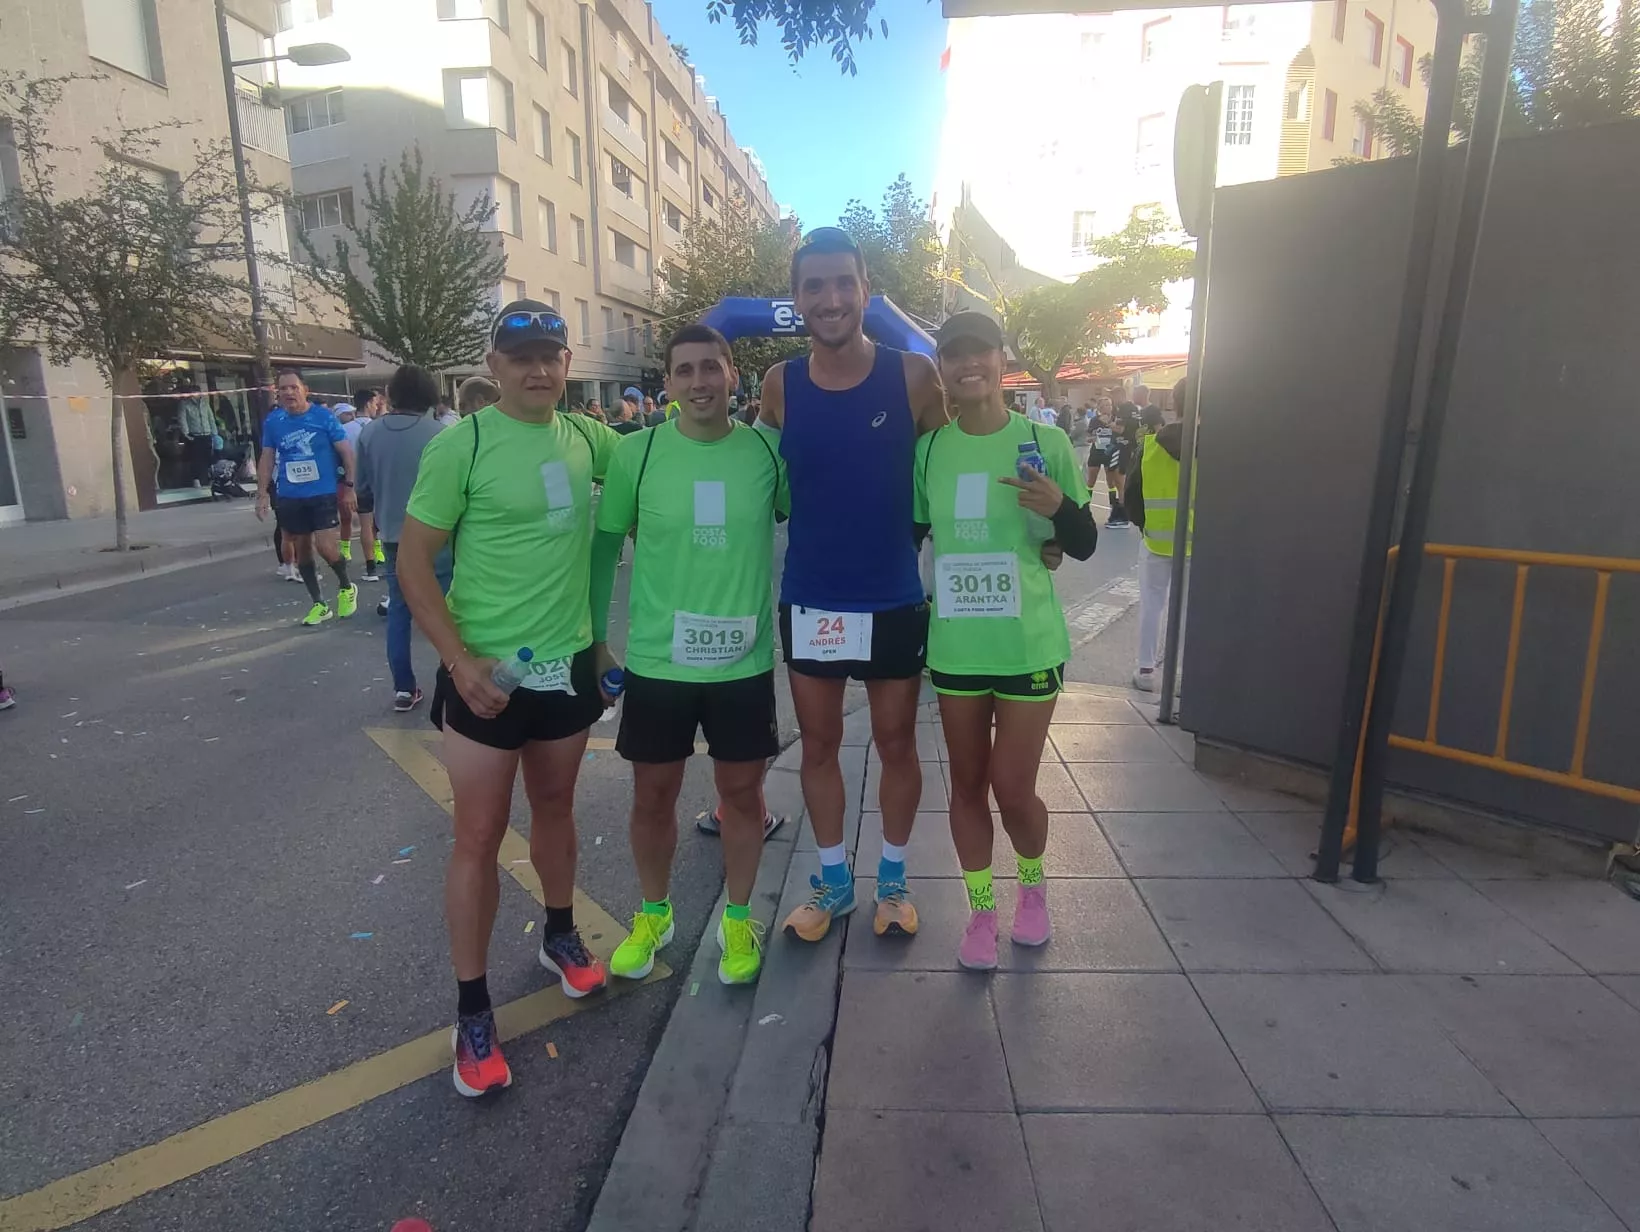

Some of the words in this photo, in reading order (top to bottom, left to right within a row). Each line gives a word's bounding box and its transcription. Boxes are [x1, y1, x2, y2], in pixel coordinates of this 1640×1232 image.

[954, 520, 989, 530] COSTA
[692, 527, 728, 536] COSTA
[955, 530, 989, 541] FOOD
[693, 536, 727, 546] FOOD
[949, 573, 1012, 593] 3018
[955, 595, 1008, 605] ARANTXA
[817, 616, 845, 635] 24
[684, 628, 744, 645] 3019
[685, 645, 742, 654] CHRISTIAN
